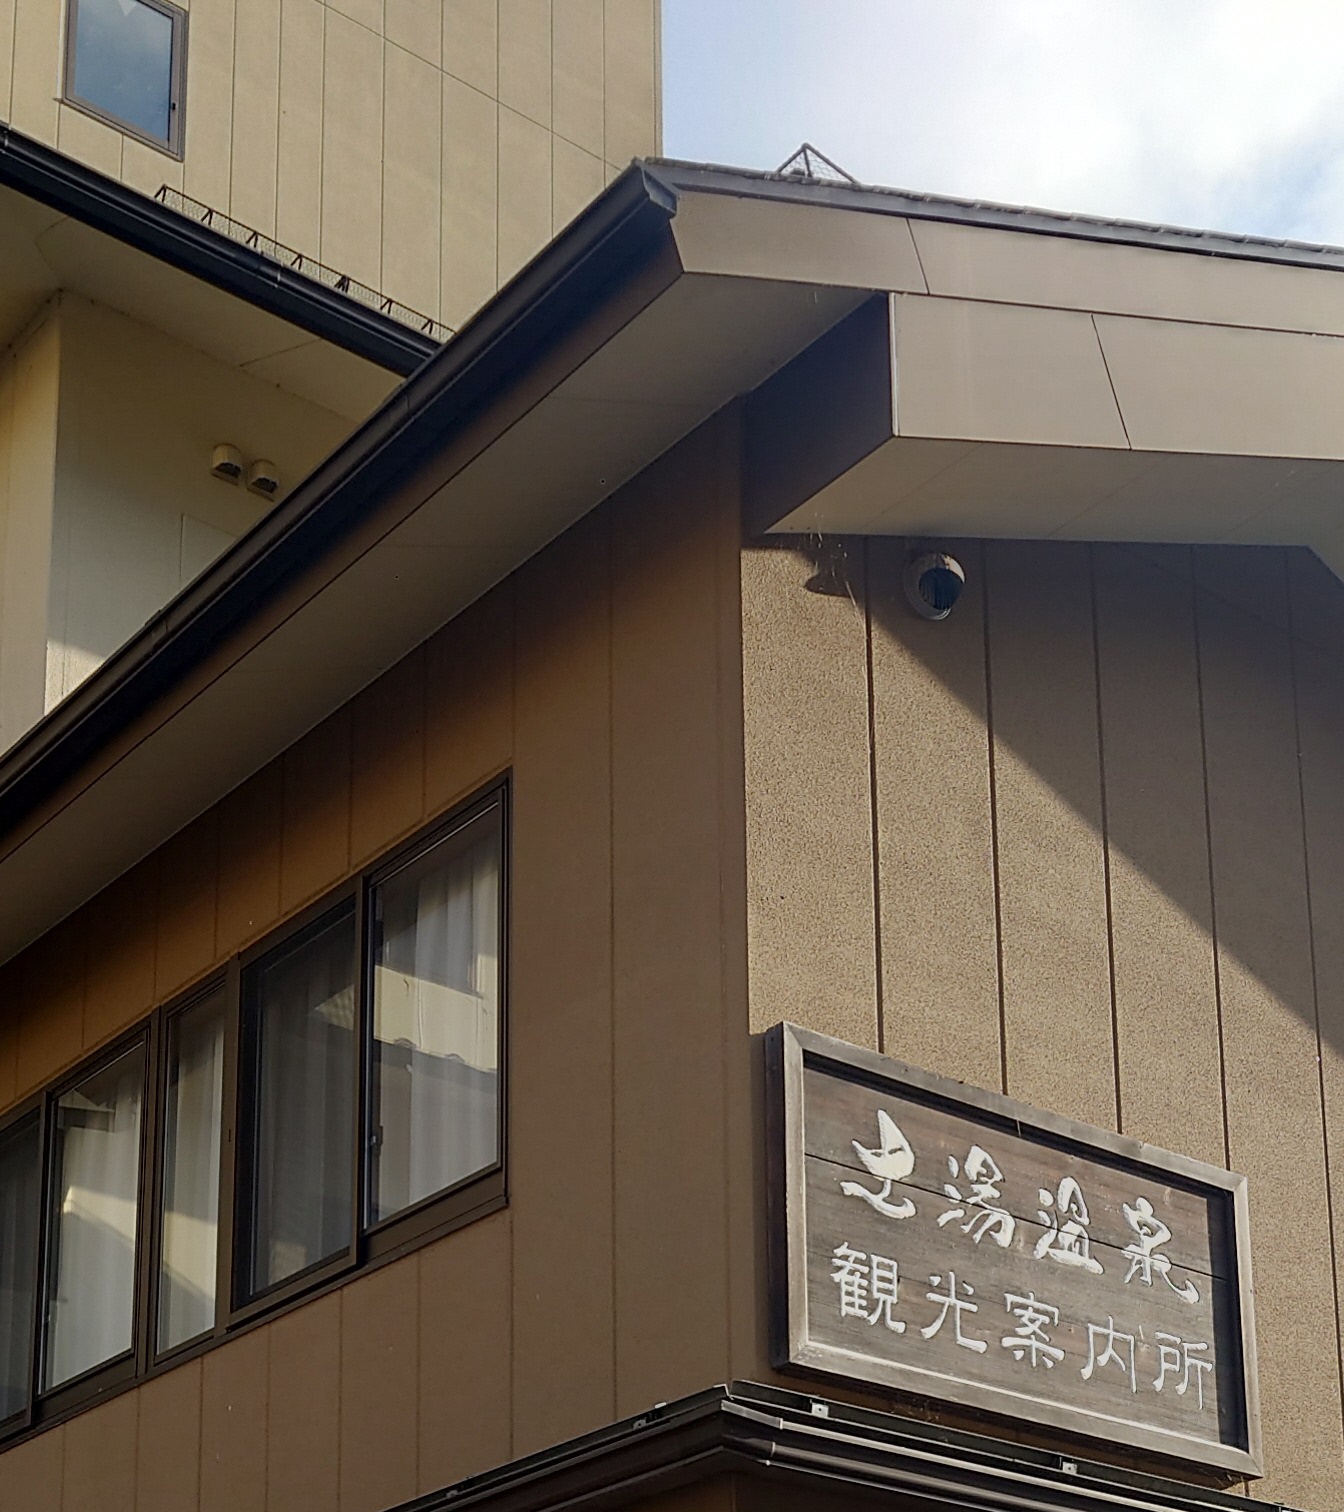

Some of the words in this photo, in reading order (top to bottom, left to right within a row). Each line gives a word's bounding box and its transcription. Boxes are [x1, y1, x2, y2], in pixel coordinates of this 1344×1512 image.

[839, 1108, 1200, 1305] 土湯温泉
[829, 1241, 1214, 1411] 観光案内所
